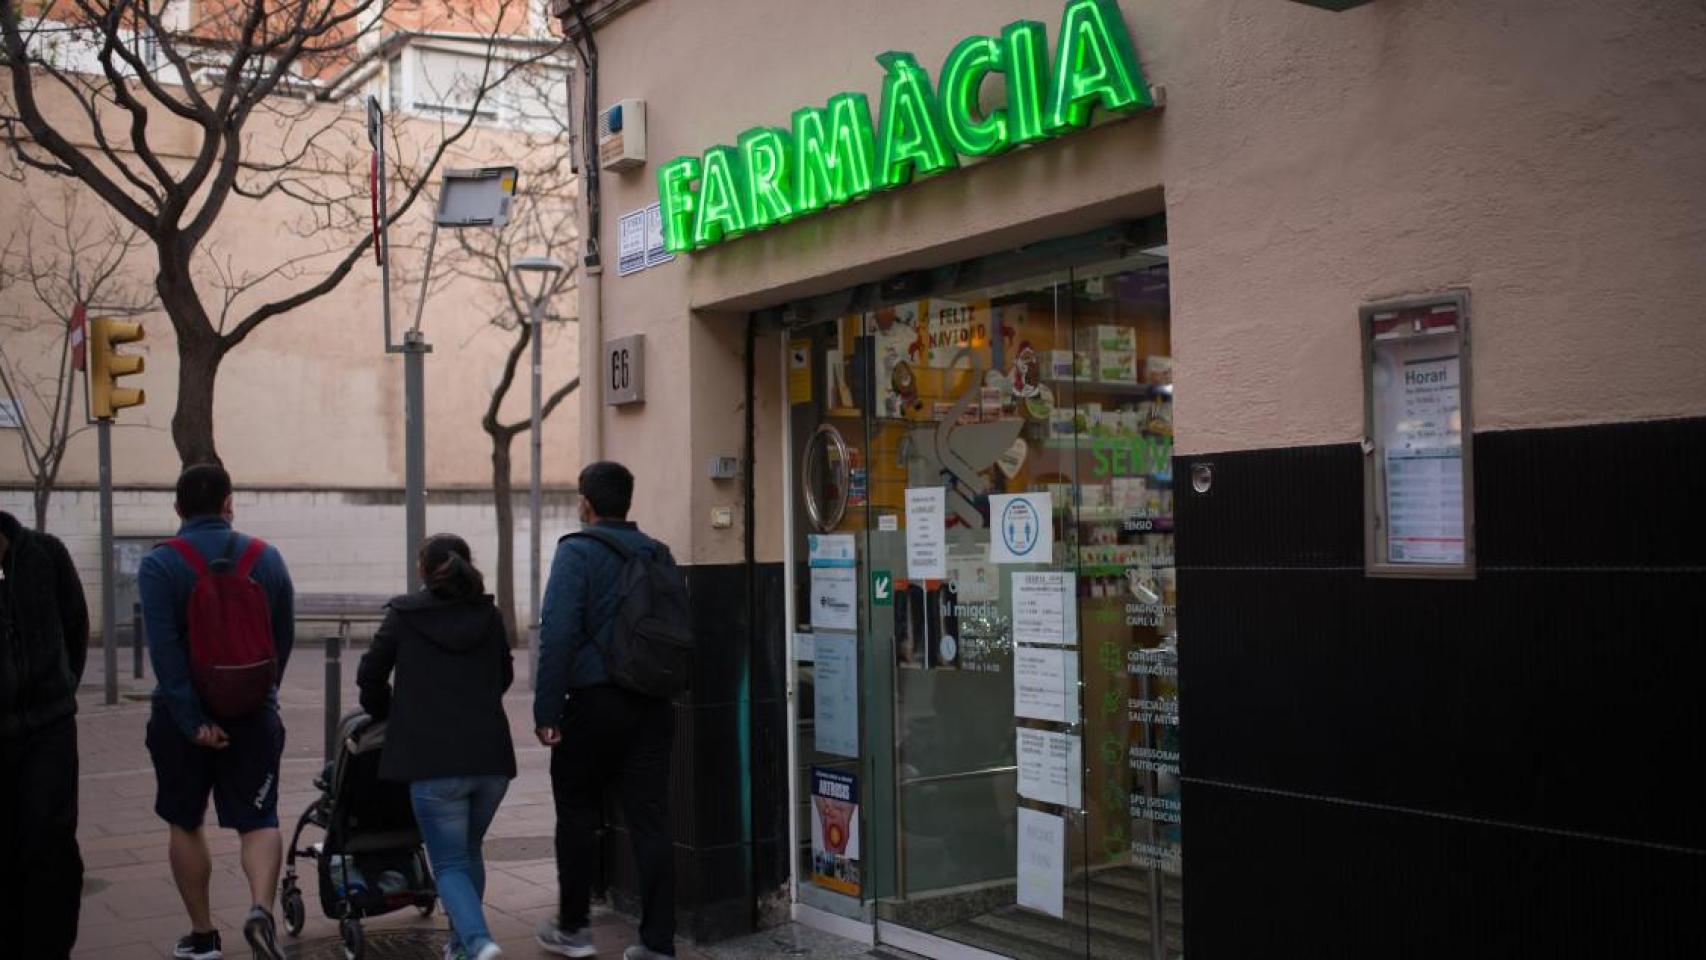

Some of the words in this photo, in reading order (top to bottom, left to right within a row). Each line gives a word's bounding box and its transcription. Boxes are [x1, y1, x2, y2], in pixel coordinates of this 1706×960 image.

[658, 0, 1152, 254] FARMÀCIA
[939, 306, 975, 325] FELIZ
[611, 348, 629, 391] 66
[1405, 367, 1447, 385] Horari
